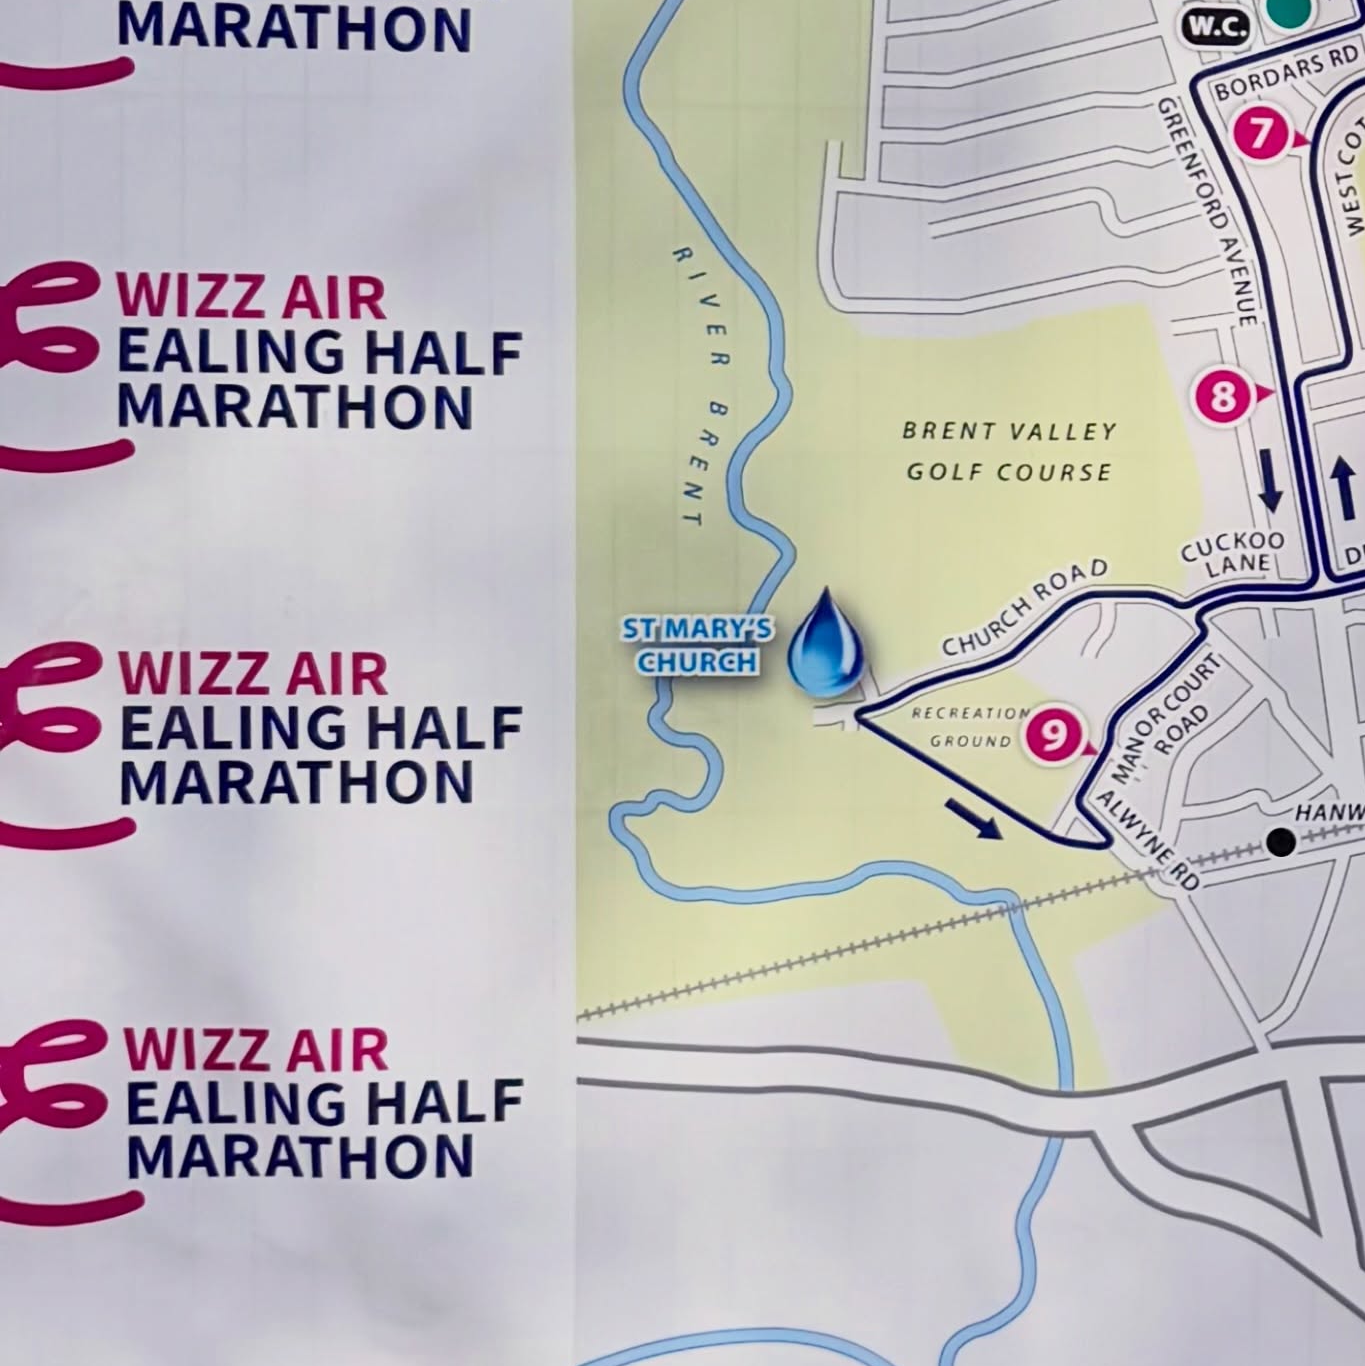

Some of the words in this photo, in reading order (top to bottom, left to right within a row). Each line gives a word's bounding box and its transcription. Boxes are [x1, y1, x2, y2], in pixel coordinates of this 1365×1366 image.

[1189, 17, 1247, 36] W.C.
[1215, 55, 1324, 101] BORDARS
[1328, 45, 1359, 67] RD
[1248, 117, 1275, 149] 7
[1211, 381, 1237, 413] 8
[903, 421, 996, 440] BRENT
[1010, 422, 1118, 441] VALLEY
[907, 463, 983, 482] GOLF
[997, 463, 1112, 482] COURSE
[942, 598, 1033, 657] CHURCH
[1033, 559, 1109, 601] ROAD
[623, 617, 656, 639] ST
[665, 617, 772, 639] MARY'S
[638, 651, 757, 673] CHURCH
[912, 707, 1031, 720] RECREATION
[931, 735, 1011, 747] GROUND
[1042, 719, 1066, 750] 9
